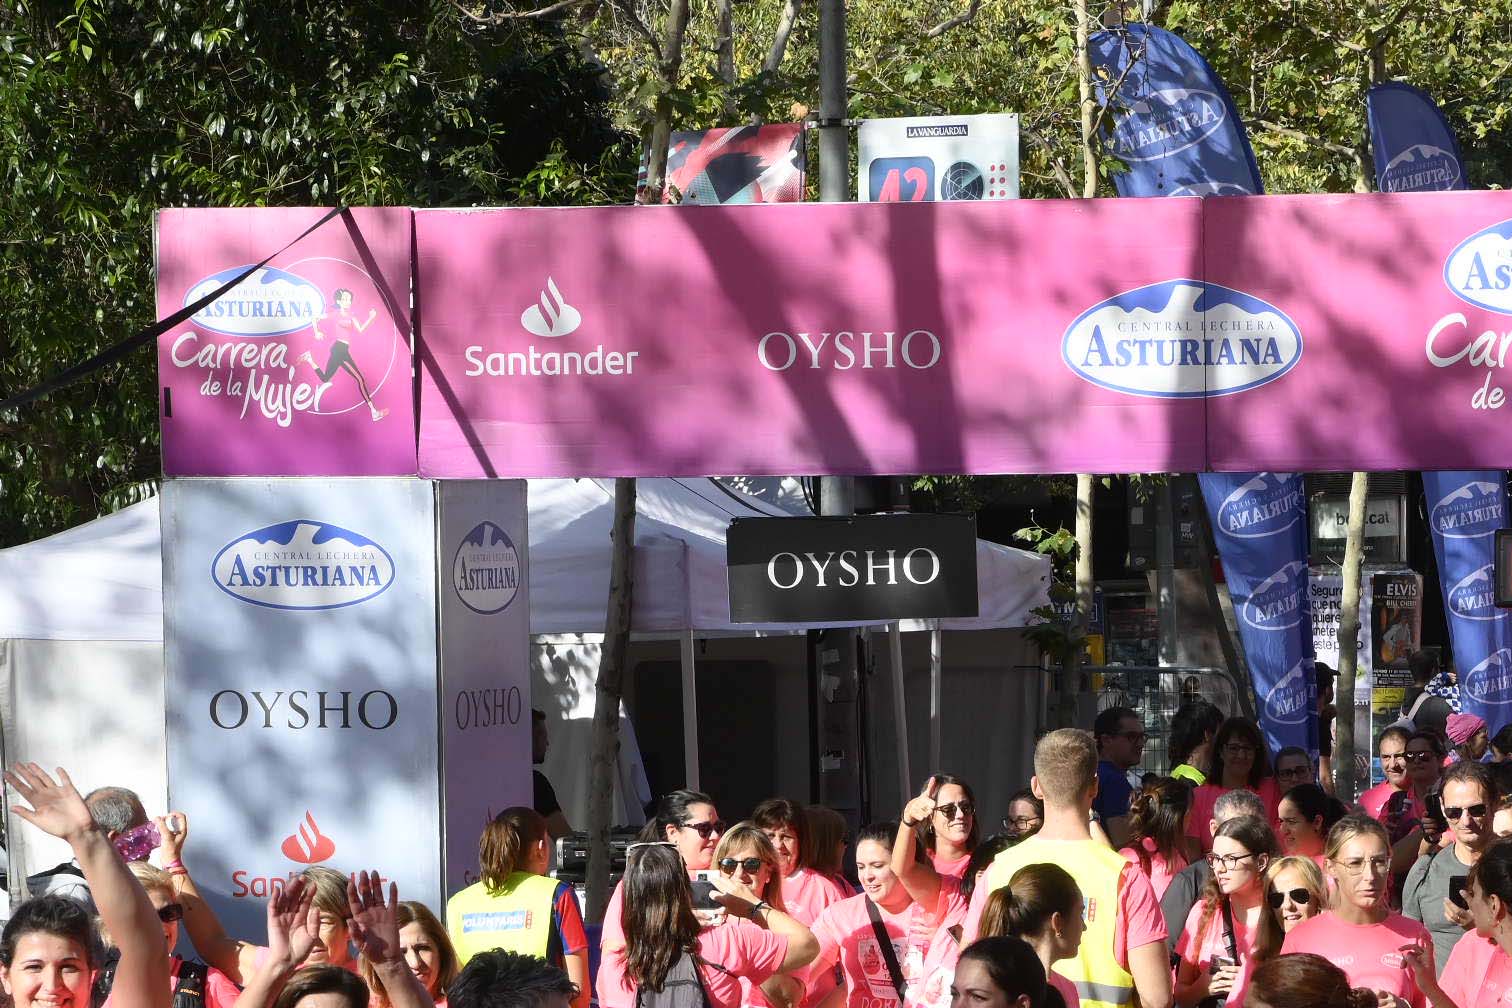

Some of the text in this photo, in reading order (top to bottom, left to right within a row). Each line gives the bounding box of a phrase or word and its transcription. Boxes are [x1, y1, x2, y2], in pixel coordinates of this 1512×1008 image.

[1118, 319, 1275, 333] CENTRAL LECHERA
[171, 331, 289, 369] Carrera
[465, 344, 639, 377] Santander
[757, 329, 941, 371] OYSHO
[1080, 325, 1282, 367] ASTURIANA
[200, 366, 333, 428] de la Mujer
[1472, 371, 1506, 410] de
[227, 553, 382, 589] ASTURIANA
[254, 551, 376, 561] CENTRAL LECHERA
[457, 553, 517, 591] ASTURIANA
[767, 547, 940, 589] OYSHO
[1386, 583, 1417, 597] ELVIS
[209, 689, 398, 731] OYSHO
[456, 685, 521, 731] OYSHO
